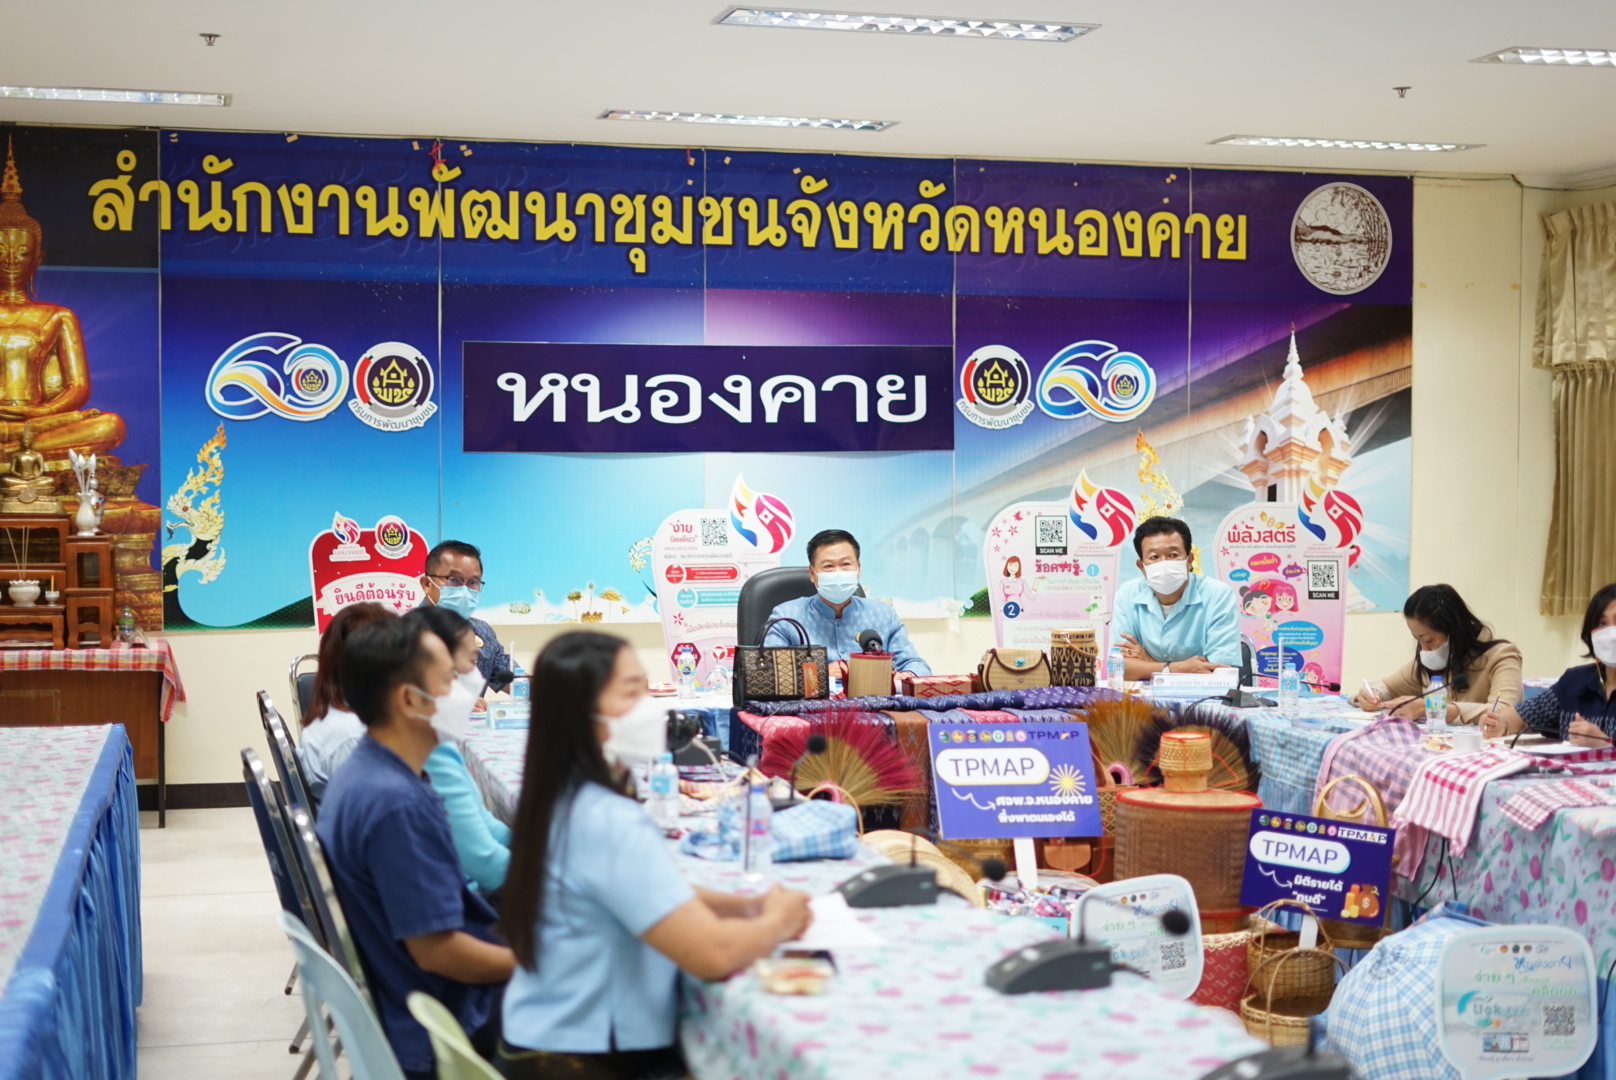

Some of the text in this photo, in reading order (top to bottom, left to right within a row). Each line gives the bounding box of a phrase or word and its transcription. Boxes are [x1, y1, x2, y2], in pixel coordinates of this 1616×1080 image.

[88, 149, 1248, 273] สำนักงานพัฒนาชุมชนจังหวัดหนองคาย
[497, 371, 928, 425] หนองคาย
[351, 400, 435, 430] กรมการพัฒนาชุมชน
[957, 399, 1033, 427] กรมการพัฒนาชุมชน
[1227, 524, 1297, 543] พลังสตรี
[333, 582, 416, 605] ยินดีต้อนรับ
[1007, 604, 1016, 616] 2
[1028, 730, 1080, 740] TPMAP
[949, 757, 1035, 777] TPMAP
[1338, 828, 1388, 843] TPMAP
[1262, 838, 1338, 865] TPMAP
[1293, 874, 1344, 892] มิติรายได้
[1292, 891, 1326, 905] "ทนดี"
